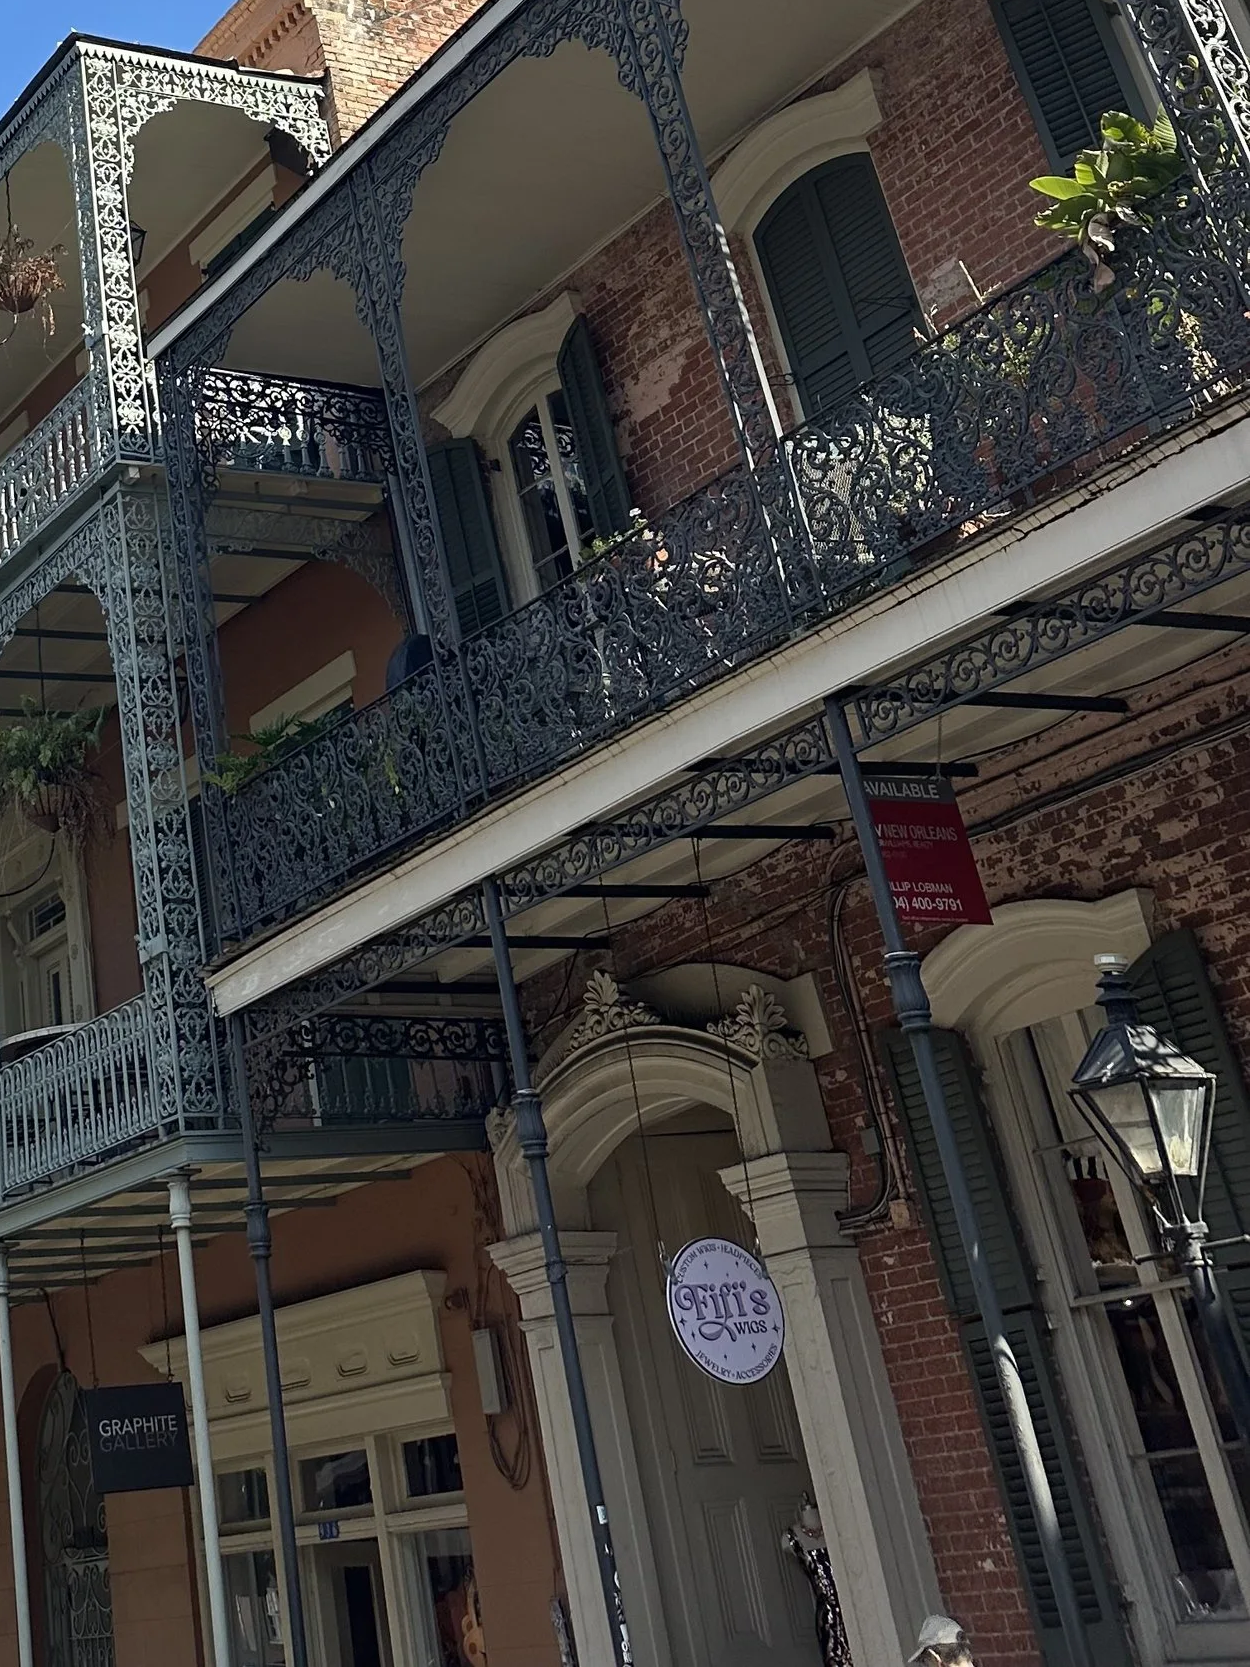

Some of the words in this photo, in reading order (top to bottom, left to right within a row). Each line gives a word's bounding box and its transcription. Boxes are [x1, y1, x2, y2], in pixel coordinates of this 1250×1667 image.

[863, 780, 940, 799] AVAILABLE
[882, 823, 908, 839] NEW
[909, 824, 958, 842] ORLEANS
[912, 882, 953, 894] LOBMAN
[911, 896, 963, 911] 400-9791
[677, 1250, 697, 1284] CUSTOM
[696, 1243, 717, 1255] WIGS
[720, 1243, 763, 1280] HEADPIECES
[674, 1280, 771, 1342] Fifi's
[733, 1319, 768, 1336] WIGS
[695, 1349, 731, 1379] JEWELRY
[735, 1343, 778, 1380] ACCESSORIES
[99, 1415, 178, 1437] GRAPHITE
[99, 1431, 178, 1453] GALLERY
